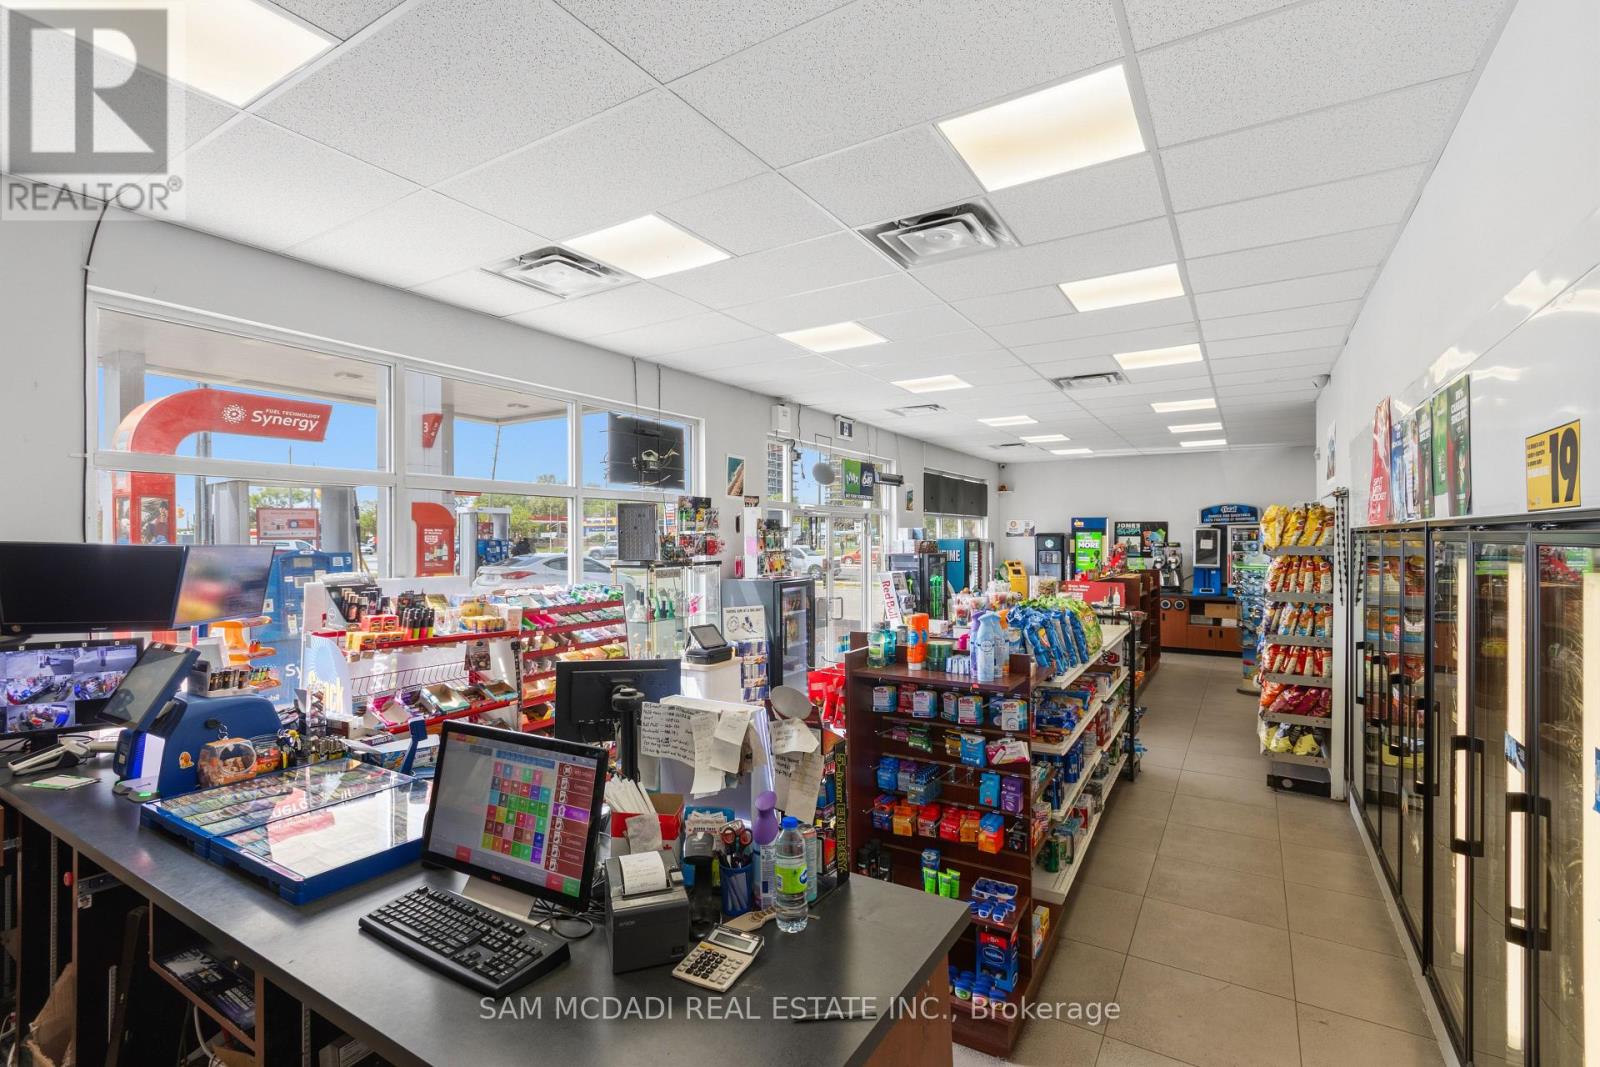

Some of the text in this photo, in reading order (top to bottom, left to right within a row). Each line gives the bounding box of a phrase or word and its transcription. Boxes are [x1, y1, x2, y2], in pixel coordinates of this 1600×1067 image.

[251, 410, 320, 432] Synergy
[282, 410, 321, 419] TECHNOLOGY
[423, 422, 429, 433] 3
[1549, 427, 1578, 504] 19
[882, 580, 898, 620] Red Bull
[837, 803, 849, 873] ENERGY
